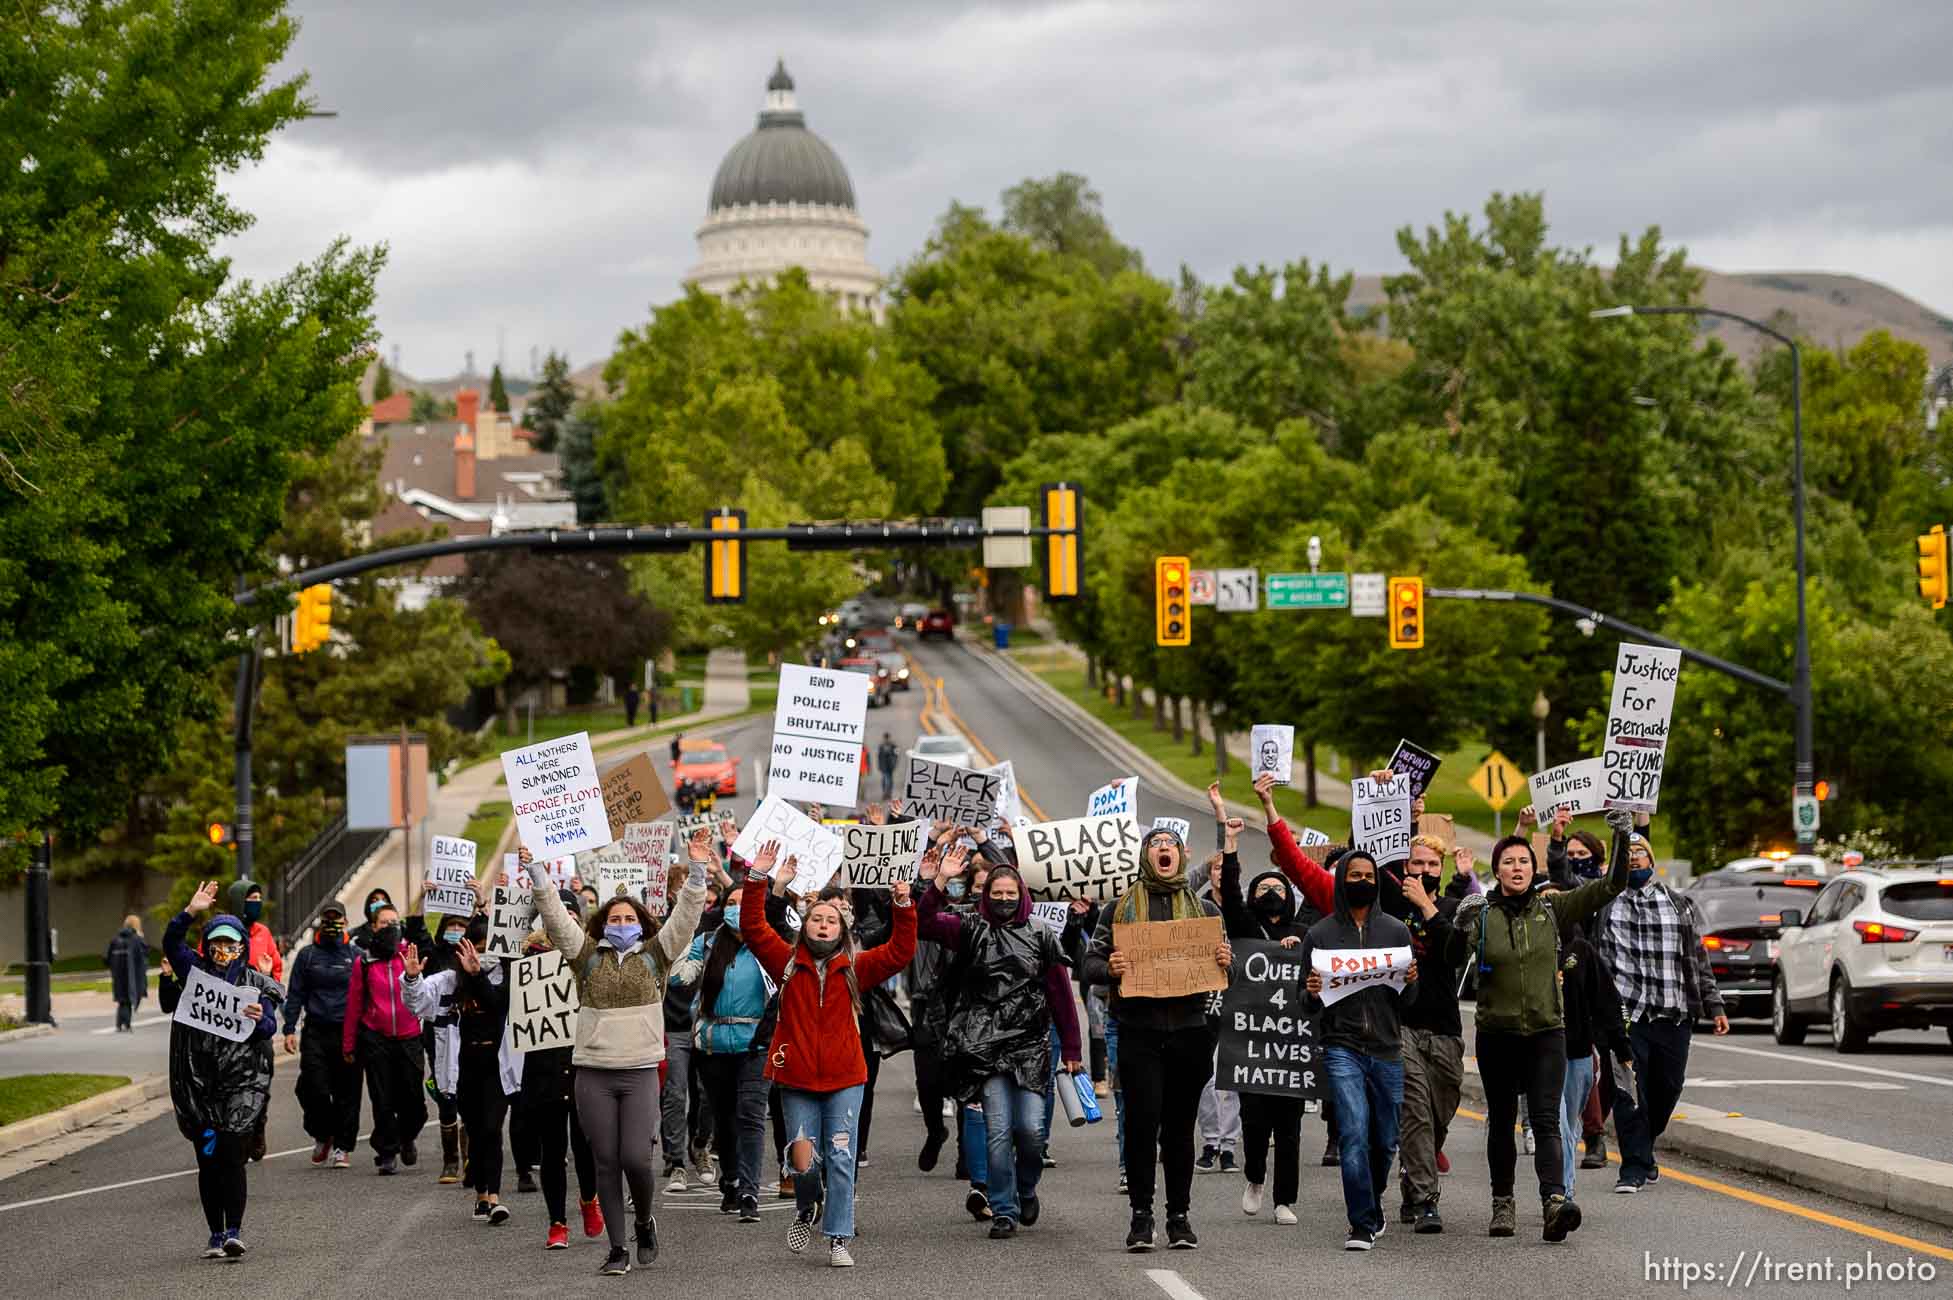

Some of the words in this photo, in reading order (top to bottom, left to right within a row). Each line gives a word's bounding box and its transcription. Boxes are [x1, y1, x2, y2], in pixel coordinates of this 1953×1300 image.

[1620, 654, 1677, 681] Justice
[809, 676, 835, 688] END
[793, 695, 840, 711] POLICE
[1622, 686, 1656, 711] For
[787, 716, 858, 735] BRUTALITY
[1609, 717, 1669, 737] Bernardo
[516, 752, 537, 766] ALL
[538, 742, 578, 760] MOTHERS
[536, 758, 560, 771] WERE
[774, 744, 792, 755] NO
[801, 747, 855, 763] JUSTICE
[1604, 750, 1664, 771] DEFUND
[521, 765, 580, 789] SUMMONED
[772, 767, 791, 779] NO
[799, 771, 844, 786] PEACE
[911, 758, 998, 801] BLACK
[1357, 777, 1407, 798] BLACK
[1535, 767, 1571, 789] BLACK
[1554, 776, 1592, 795] LIVES
[1606, 770, 1661, 799] SLCPD
[542, 784, 566, 796] WHEN
[907, 784, 990, 812] LIVES
[515, 795, 561, 816] GEORGE
[563, 787, 601, 805] FLOYD
[534, 808, 567, 824] CALLED
[569, 804, 586, 815] OUT
[545, 821, 563, 832] FOR
[566, 817, 580, 828] HIS
[904, 801, 991, 828] MATTER
[1363, 808, 1402, 831] LIVES
[545, 827, 587, 846] MOMMA
[845, 825, 920, 860] SILENCE
[1028, 818, 1139, 863] BLACK
[436, 840, 474, 859] BLACK
[848, 860, 916, 885] VIOLENCE
[877, 857, 890, 867] IS
[1046, 849, 1135, 883] LIVES
[436, 867, 470, 883] LIVES
[427, 889, 474, 906] MATTER
[1030, 903, 1066, 922] LIVES
[519, 955, 569, 987] BLA
[1329, 970, 1398, 989] SHOOT
[523, 979, 572, 1014] LIV
[1269, 988, 1288, 1010] 4
[190, 1002, 241, 1034] SHOOT
[513, 1010, 573, 1048] MAT
[1234, 1011, 1313, 1037] BLACK
[1247, 1040, 1311, 1063] LIVES
[1233, 1065, 1316, 1088] MATTER
